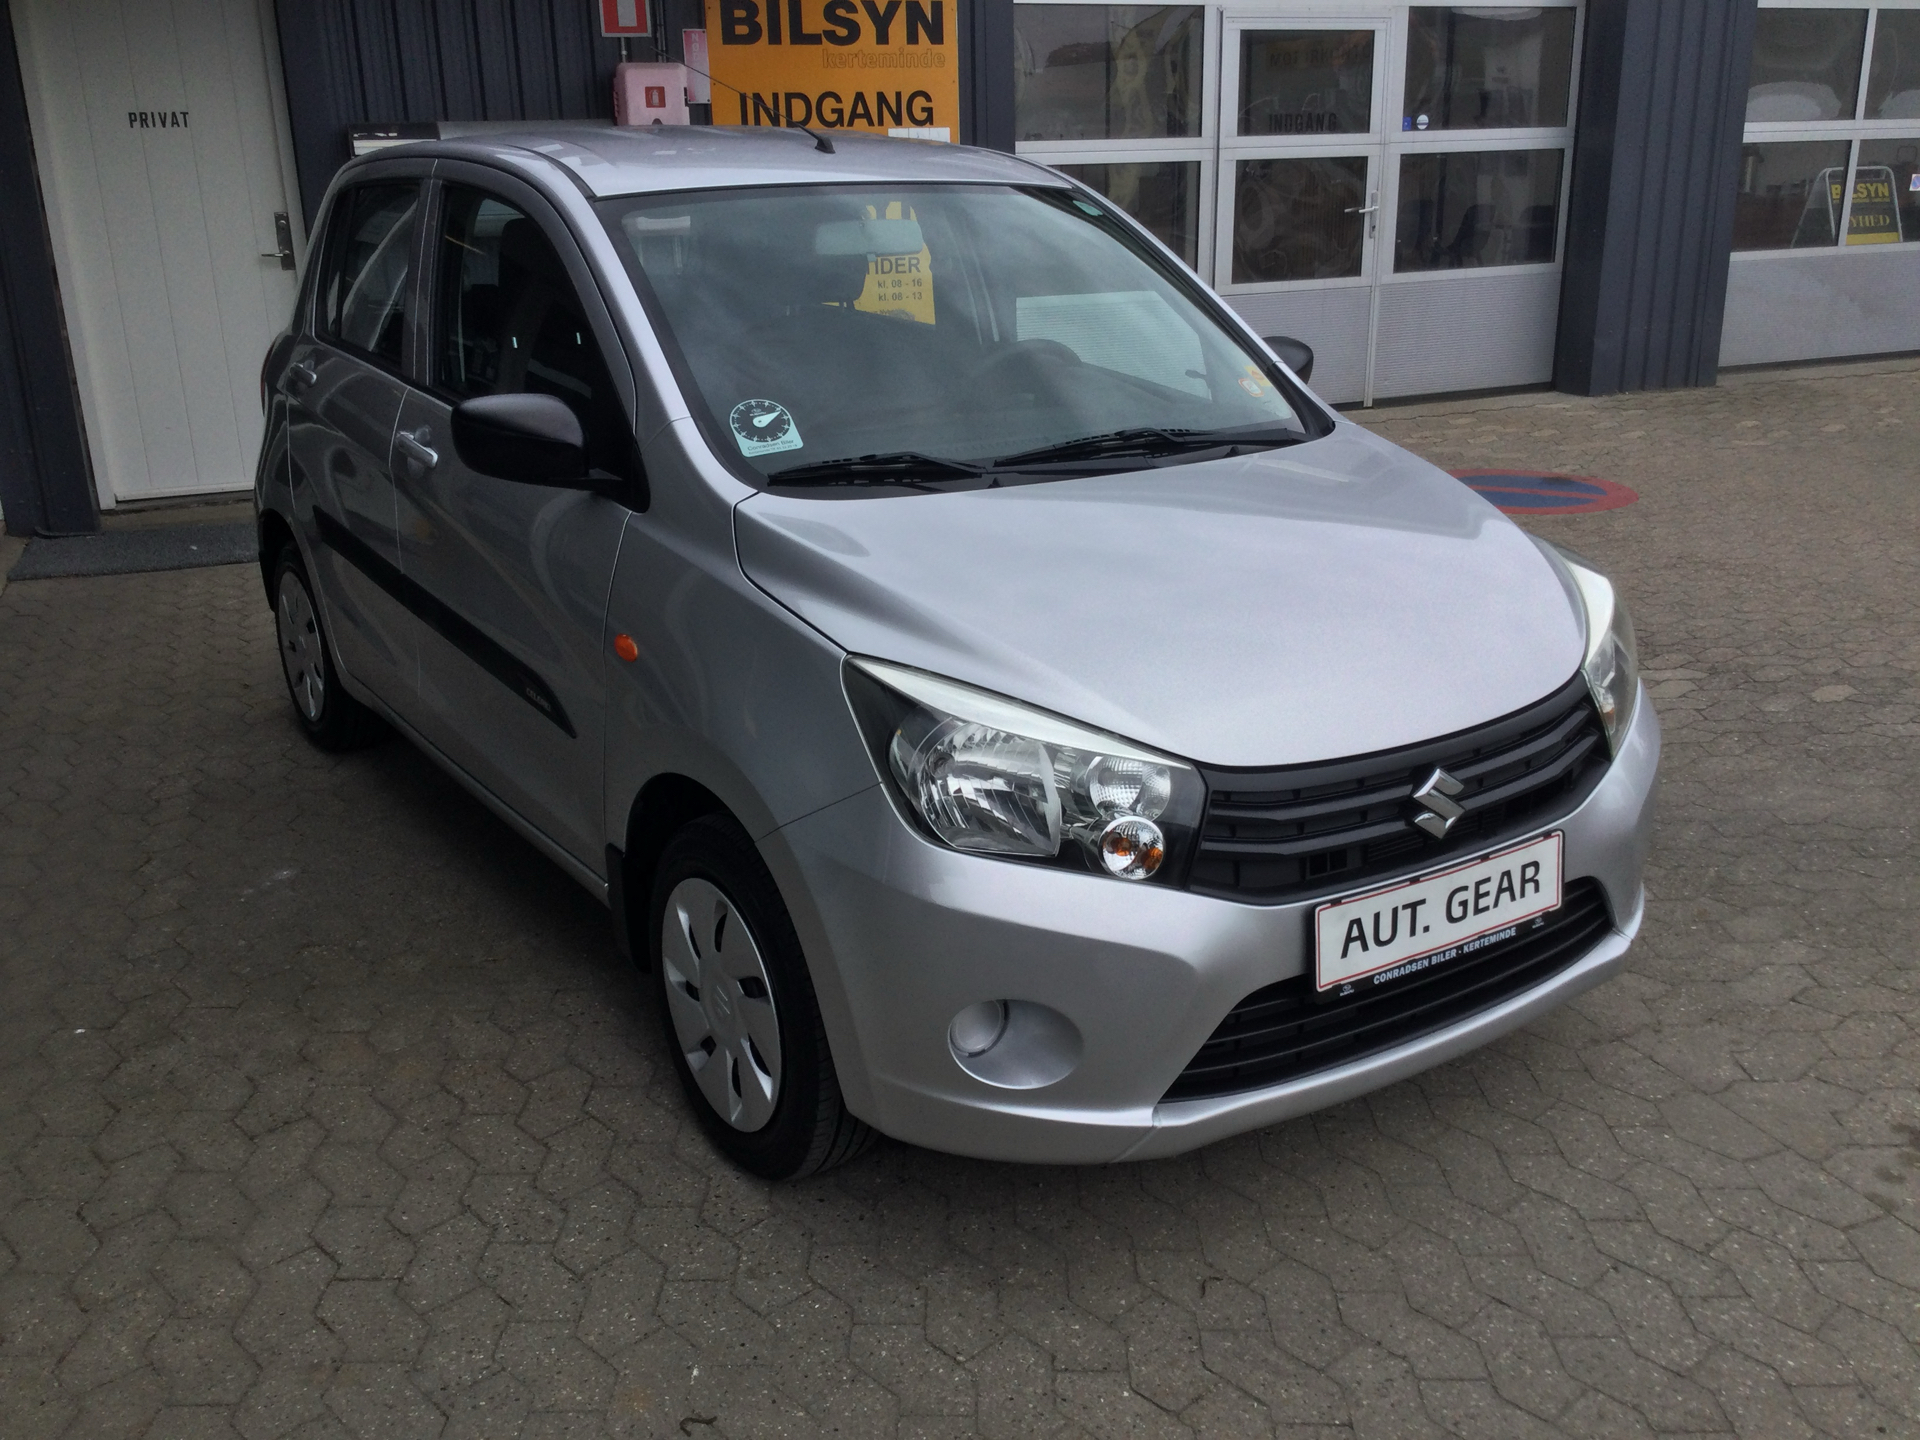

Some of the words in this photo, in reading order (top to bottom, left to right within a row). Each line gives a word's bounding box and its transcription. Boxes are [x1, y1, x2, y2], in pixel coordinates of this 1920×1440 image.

[721, 0, 945, 46] BILSYN
[822, 48, 946, 69] kerteminde
[128, 111, 189, 129] PRIVAT
[739, 90, 935, 128] INDGANG
[1268, 112, 1338, 134] INDGANG
[877, 279, 889, 289] kl.
[891, 279, 902, 288] 08
[911, 278, 923, 287] 16
[878, 292, 890, 302] kl.
[891, 292, 903, 301] 08
[911, 291, 923, 300] 13
[1340, 898, 1430, 960] AUT.
[1445, 860, 1541, 924] GEAR
[1373, 958, 1429, 985] CONRADSEN
[1431, 948, 1457, 966] BILER
[1463, 926, 1517, 953] KERTEMINDE
